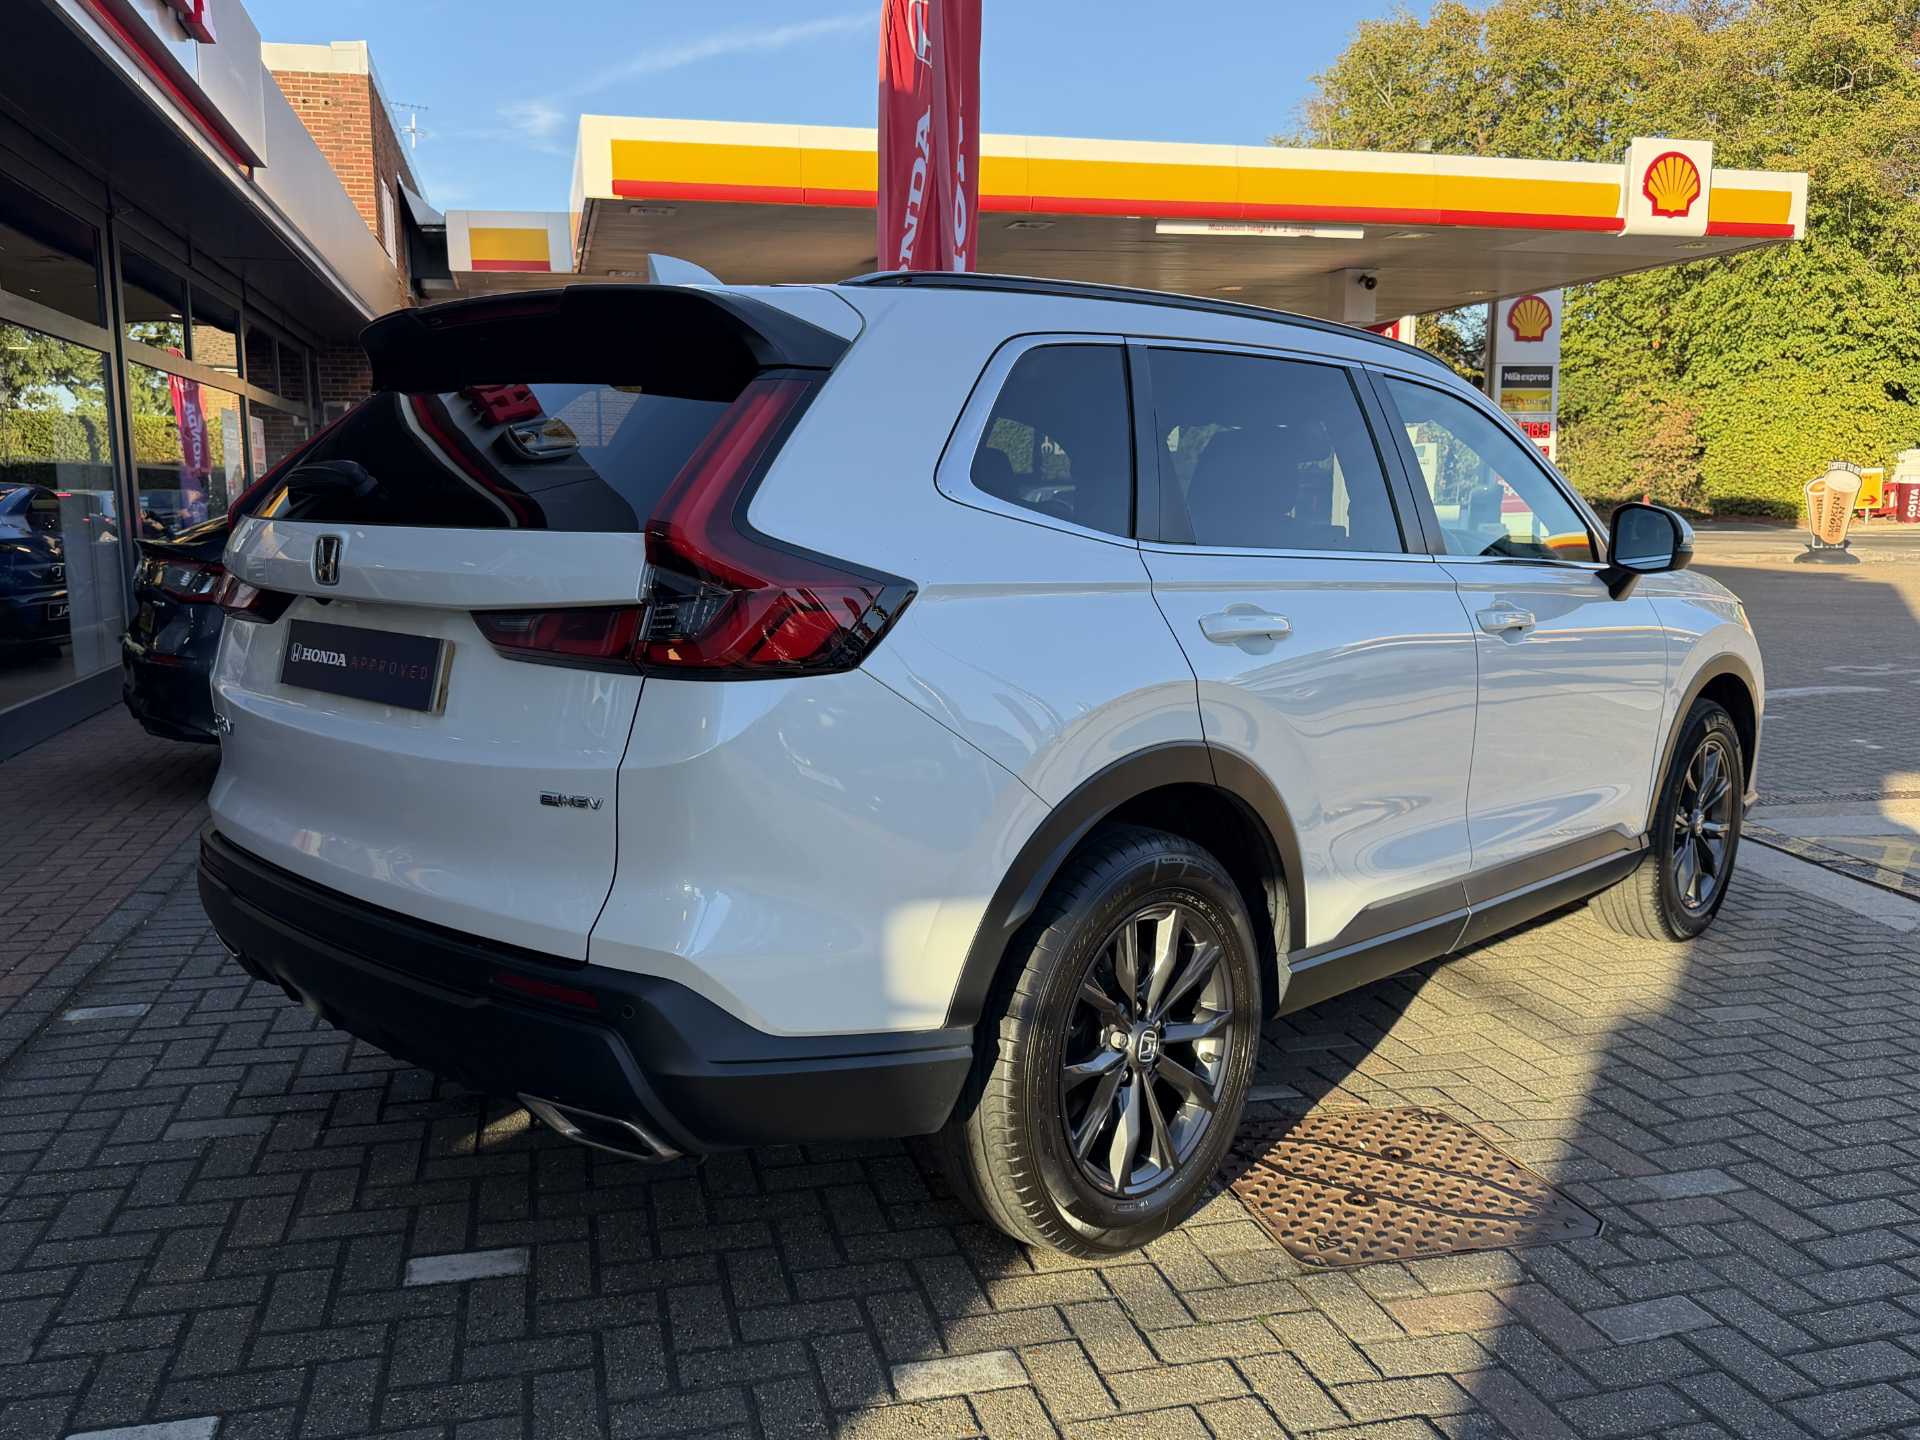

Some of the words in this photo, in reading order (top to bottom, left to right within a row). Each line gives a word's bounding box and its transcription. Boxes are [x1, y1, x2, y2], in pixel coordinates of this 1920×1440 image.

[1907, 488, 1920, 518] COSTA
[302, 647, 347, 667] HONDA
[351, 656, 429, 681] APPROVED
